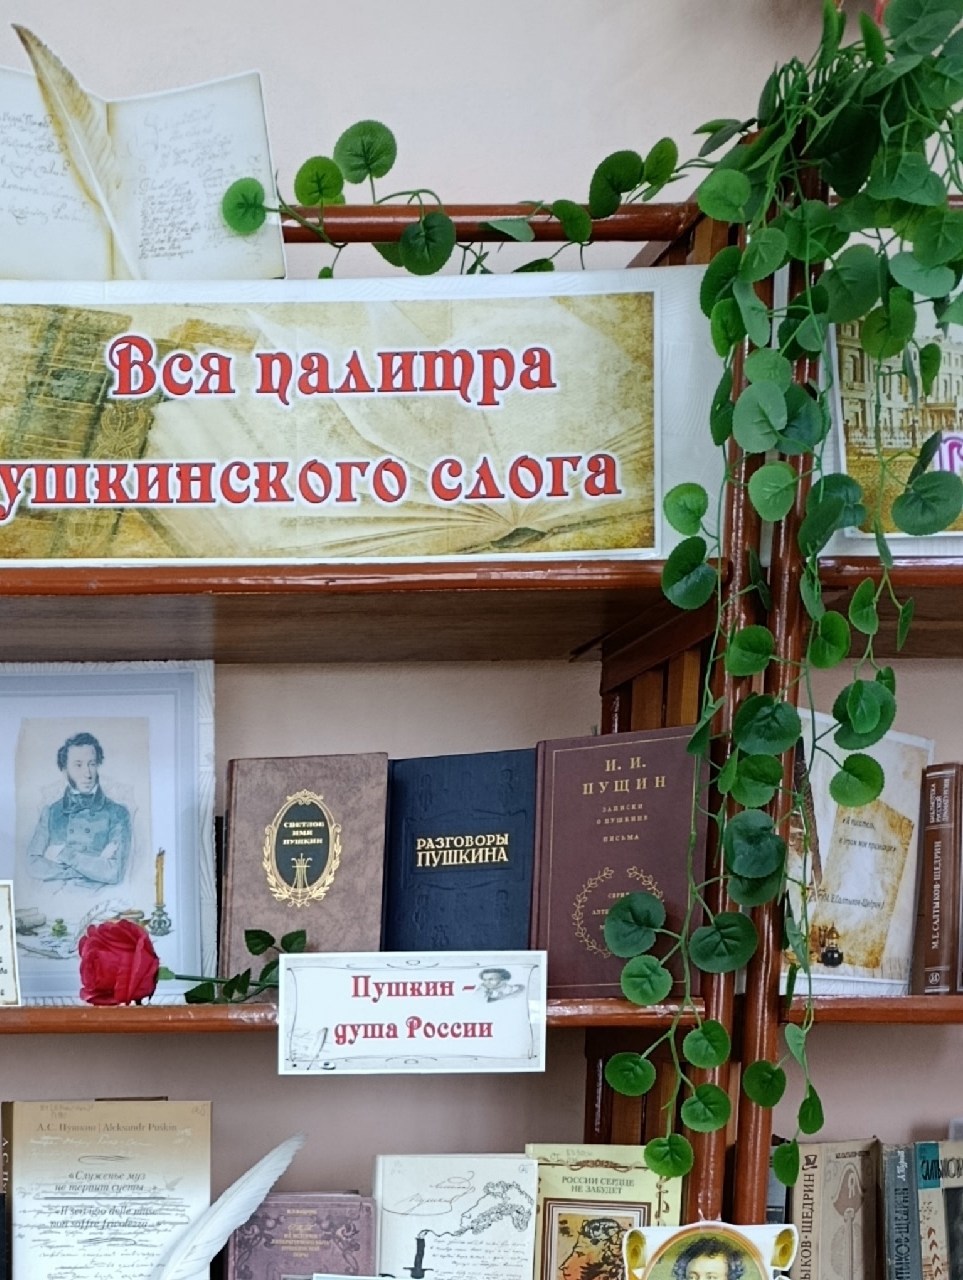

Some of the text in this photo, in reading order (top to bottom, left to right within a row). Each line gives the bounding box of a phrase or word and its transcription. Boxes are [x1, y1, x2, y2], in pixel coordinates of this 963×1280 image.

[108, 334, 556, 405] Вся палитра
[431, 452, 621, 501] слога
[605, 756, 647, 772] И. И.
[582, 774, 668, 796] ПУЩИН
[601, 803, 644, 813] ЗАПИСКИ
[416, 833, 509, 851] РАЗГОВОРЫ
[603, 834, 640, 843] ПИСЬМА
[416, 846, 509, 868] ПУШКИНА
[351, 975, 454, 1003] Пушкин
[334, 1016, 494, 1045] душа России
[36, 1123, 96, 1133] А.С. Пушкин
[102, 1122, 146, 1132] Aleksandr
[127, 1172, 146, 1181] муз
[561, 1175, 635, 1188] РОССИИ СЕРДЦЕ
[571, 1184, 623, 1196] НЕ ЗАБУДЕТ
